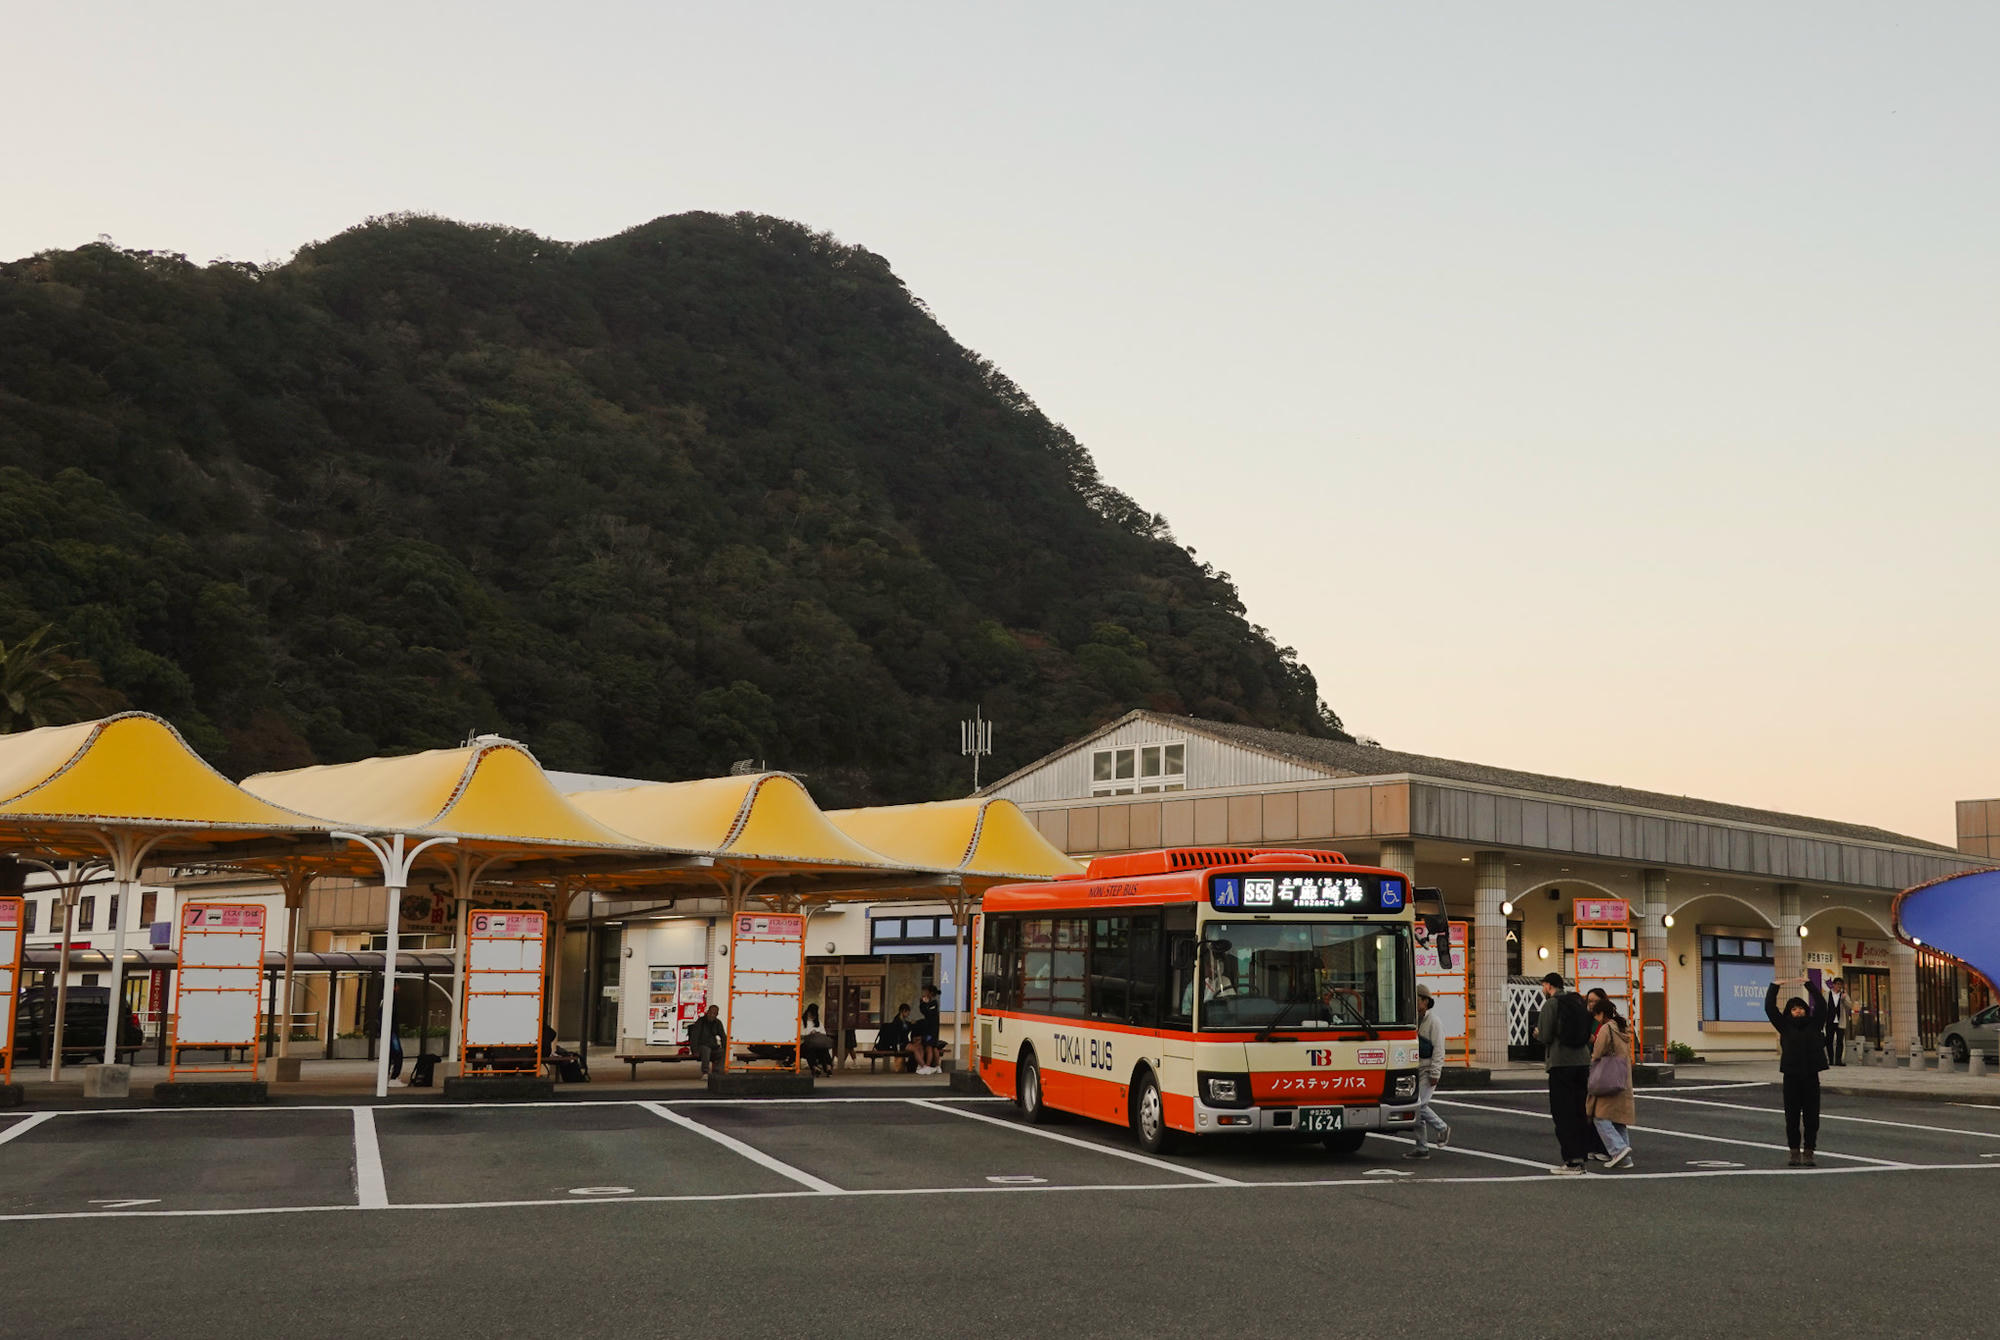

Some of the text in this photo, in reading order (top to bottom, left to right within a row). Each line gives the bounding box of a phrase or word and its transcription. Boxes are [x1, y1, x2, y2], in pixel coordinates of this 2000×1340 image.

[1123, 883, 1138, 896] BUS
[1246, 882, 1272, 901] S53
[190, 909, 203, 925] 7
[476, 915, 488, 930] 6
[740, 918, 752, 932] 5
[1415, 953, 1460, 966] 後方意
[1053, 1033, 1113, 1071] TOKAI BUS
[1271, 1077, 1367, 1091] ノンステップバス
[1309, 1115, 1342, 1131] 16-24
[87, 1199, 162, 1208] 7
